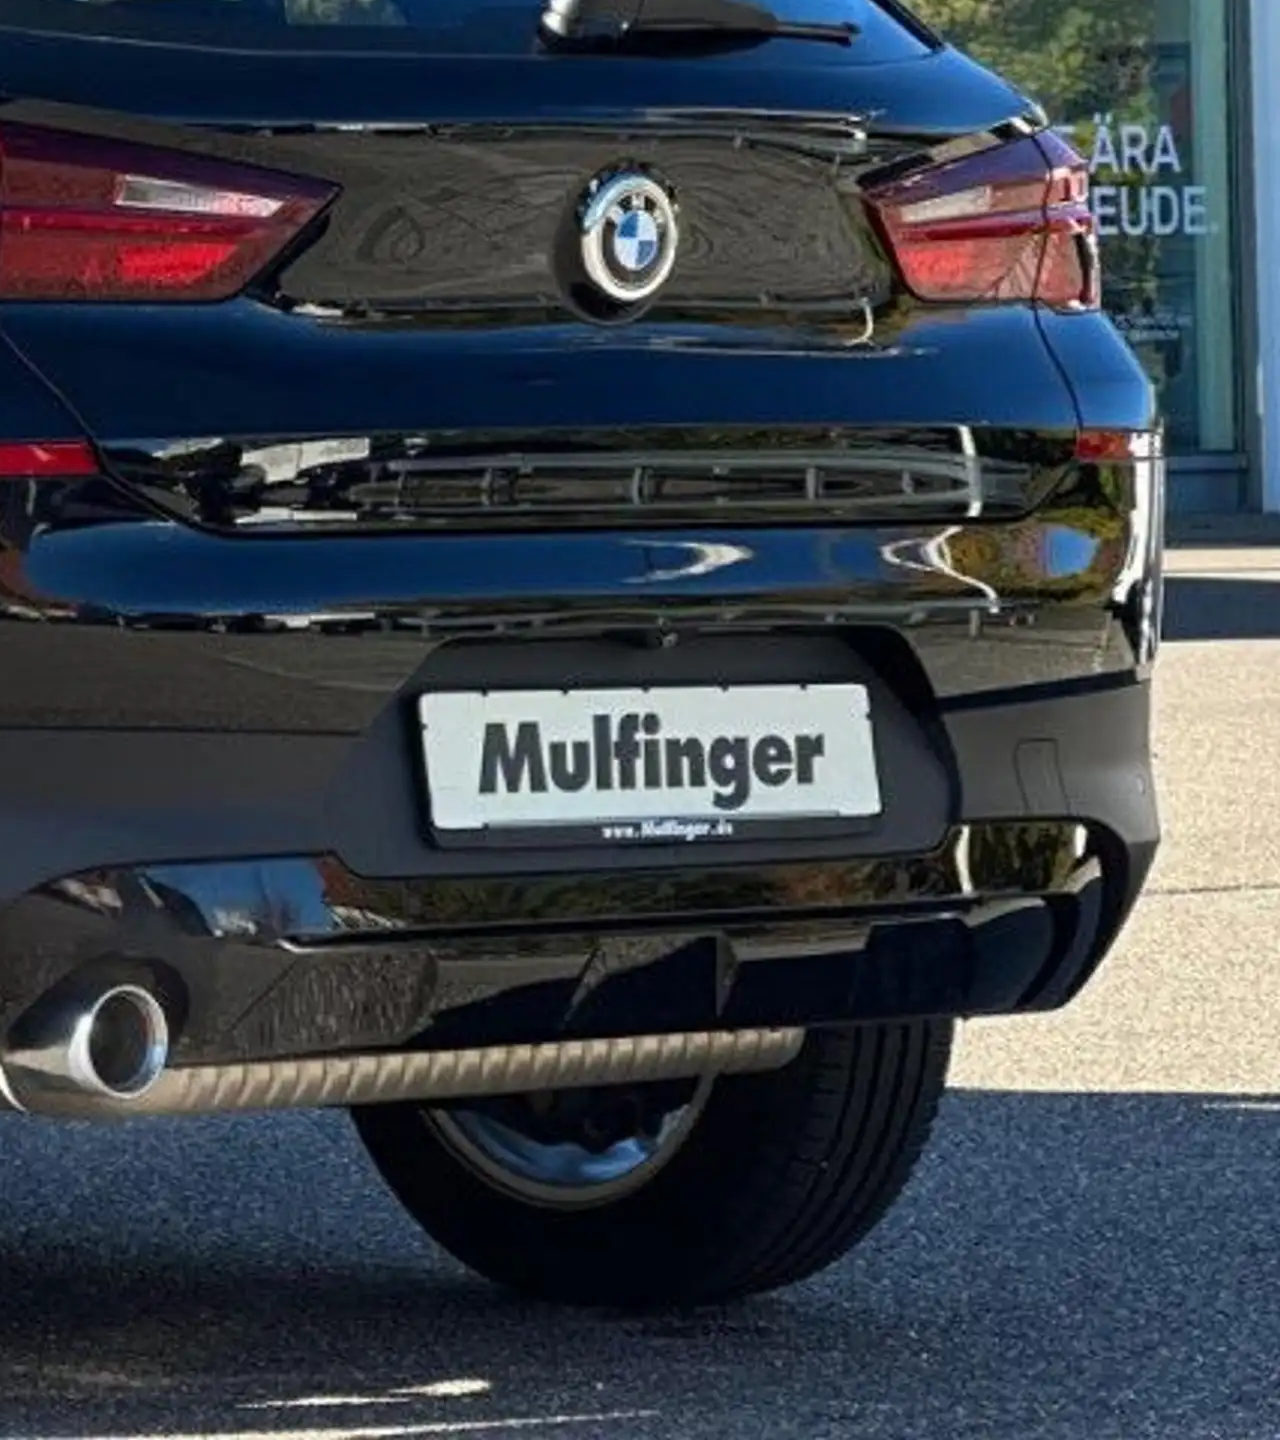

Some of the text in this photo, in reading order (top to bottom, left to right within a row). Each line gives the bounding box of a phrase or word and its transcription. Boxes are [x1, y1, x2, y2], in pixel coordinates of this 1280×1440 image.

[1090, 112, 1182, 175] ÄRA
[1092, 185, 1220, 237] EUDE.
[478, 713, 826, 811] Mulfinger
